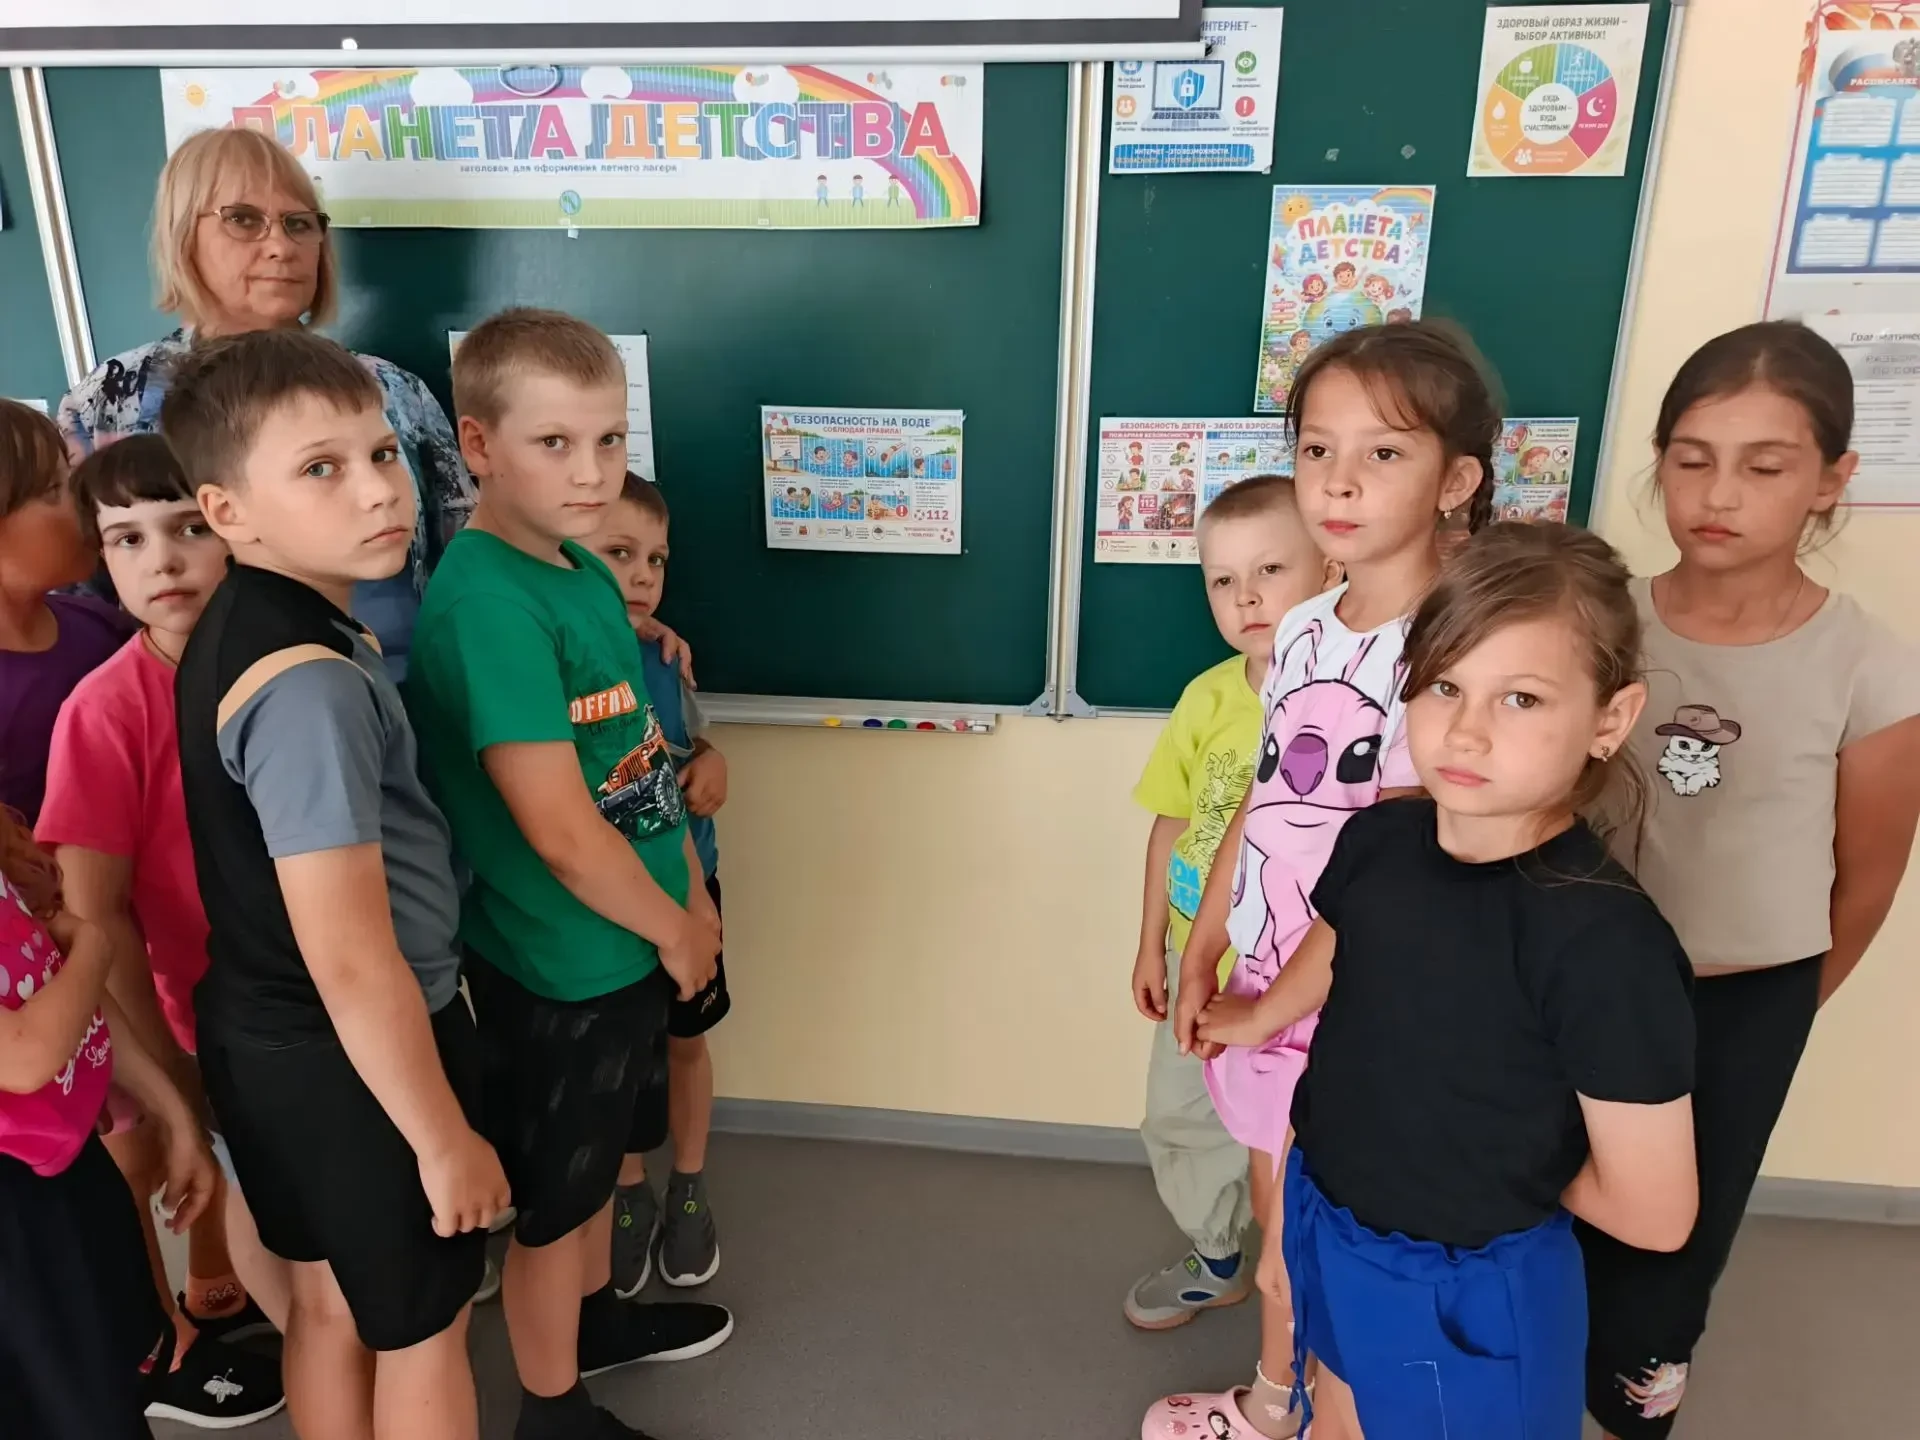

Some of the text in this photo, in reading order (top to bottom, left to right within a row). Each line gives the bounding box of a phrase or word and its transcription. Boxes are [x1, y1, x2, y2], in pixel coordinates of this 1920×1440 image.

[1496, 15, 1551, 29] ЗДОРОВЫЙ
[1551, 16, 1583, 27] ОБРАЗ
[1584, 16, 1620, 26] ЖИЗНИ
[1514, 30, 1607, 41] ВЫБОР АКТИВНЫХ!
[603, 100, 952, 160] ДЕТСТВА
[460, 164, 677, 174] заголовок для оформления летнего лагеря
[1298, 213, 1403, 240] ПЛАНЕТА
[1299, 238, 1400, 266] ДЕТСТВА
[793, 414, 931, 428] БЕЗОПАСНОСТЬ НА ВОДЕ
[1120, 422, 1180, 430] БЕЗОПАСНОСТЬ
[1181, 421, 1206, 430] ДЕТЕЙ
[1214, 422, 1243, 430] ЗАБОТА
[823, 426, 902, 435] СОБЛЮДАЙ ПРАВИЛА!
[1140, 499, 1155, 507] 112
[926, 509, 949, 521] 112
